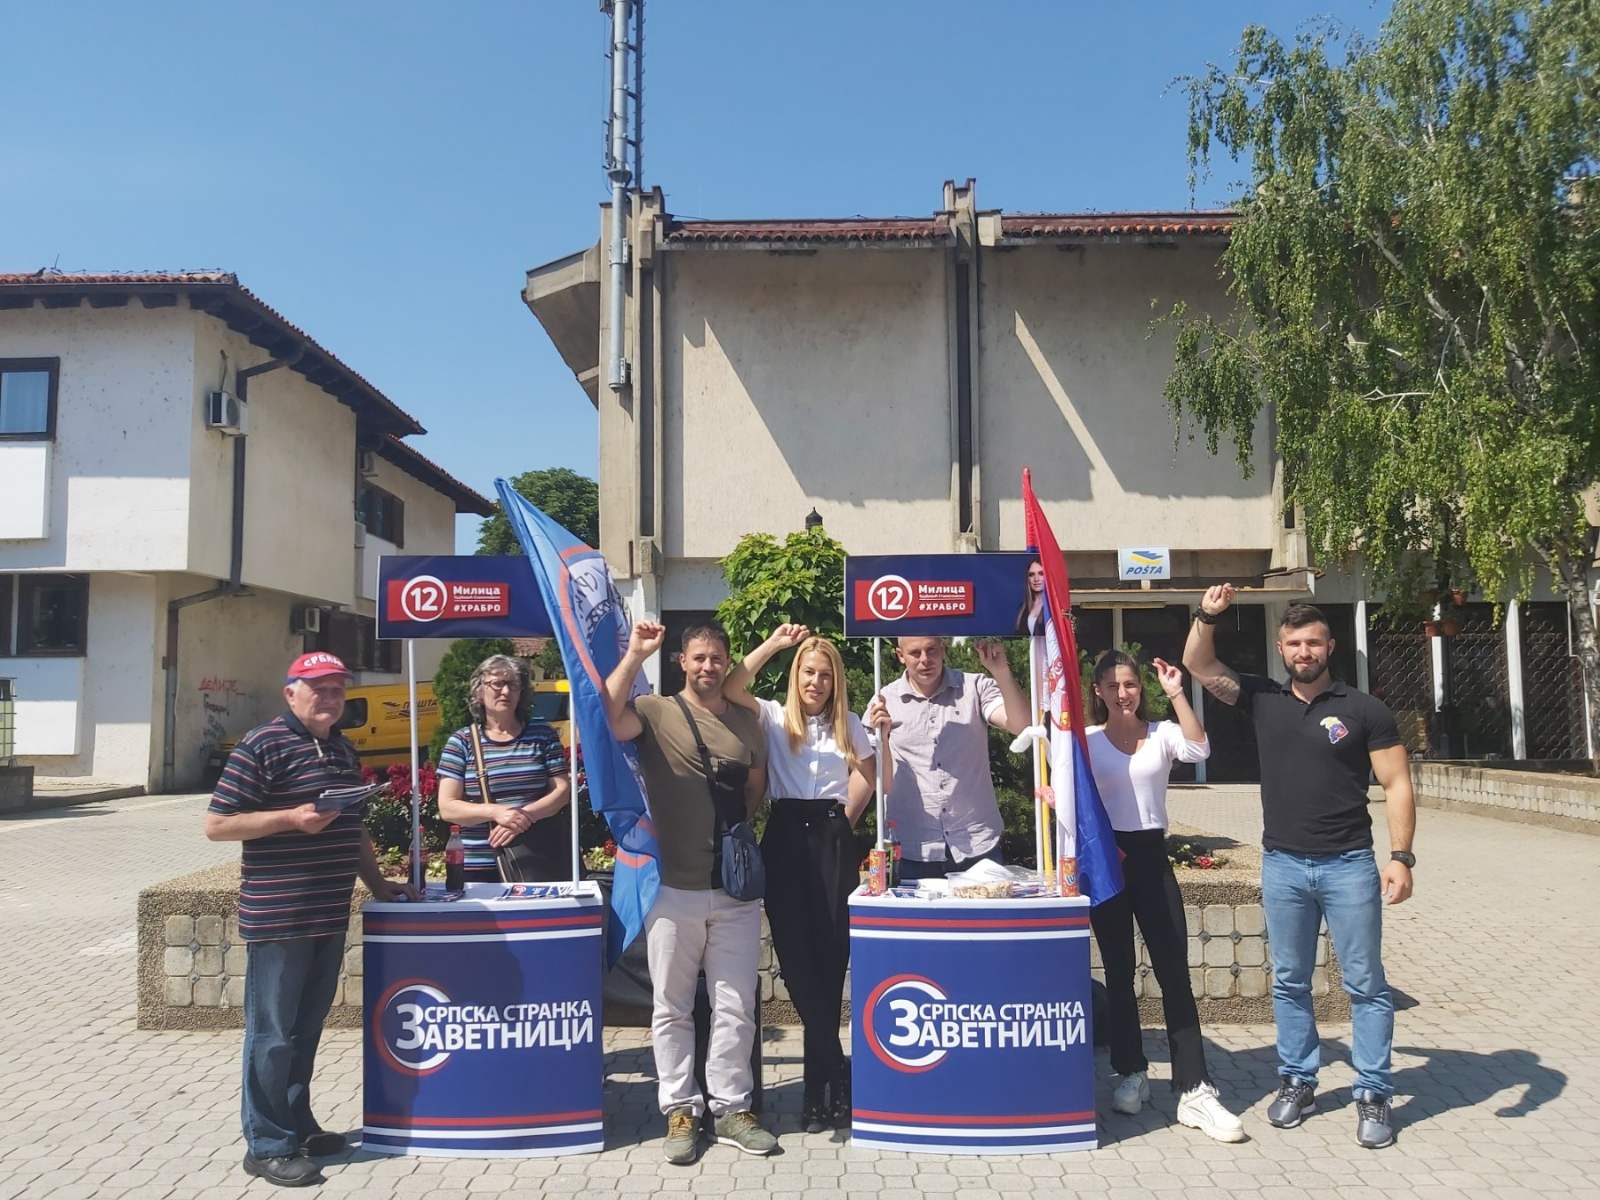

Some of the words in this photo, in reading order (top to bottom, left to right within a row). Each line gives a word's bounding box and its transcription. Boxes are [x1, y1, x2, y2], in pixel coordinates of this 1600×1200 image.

[410, 587, 438, 611] 12
[453, 586, 500, 596] Милица
[876, 586, 904, 610] 12
[918, 585, 966, 594] Милица
[453, 604, 501, 612] #ХРАБРО
[919, 603, 966, 611] #ХРАБРО
[403, 698, 438, 710] ПШТА
[424, 1005, 500, 1023] СРПСКА
[503, 1000, 593, 1022] СТРАНКА
[919, 1004, 996, 1021] СРПСКА
[999, 1001, 1085, 1021] СТРАНКА
[395, 1003, 594, 1051] ЗАВЕТНИЦИ
[889, 999, 1087, 1051] ЗАВЕТНИЦИ
